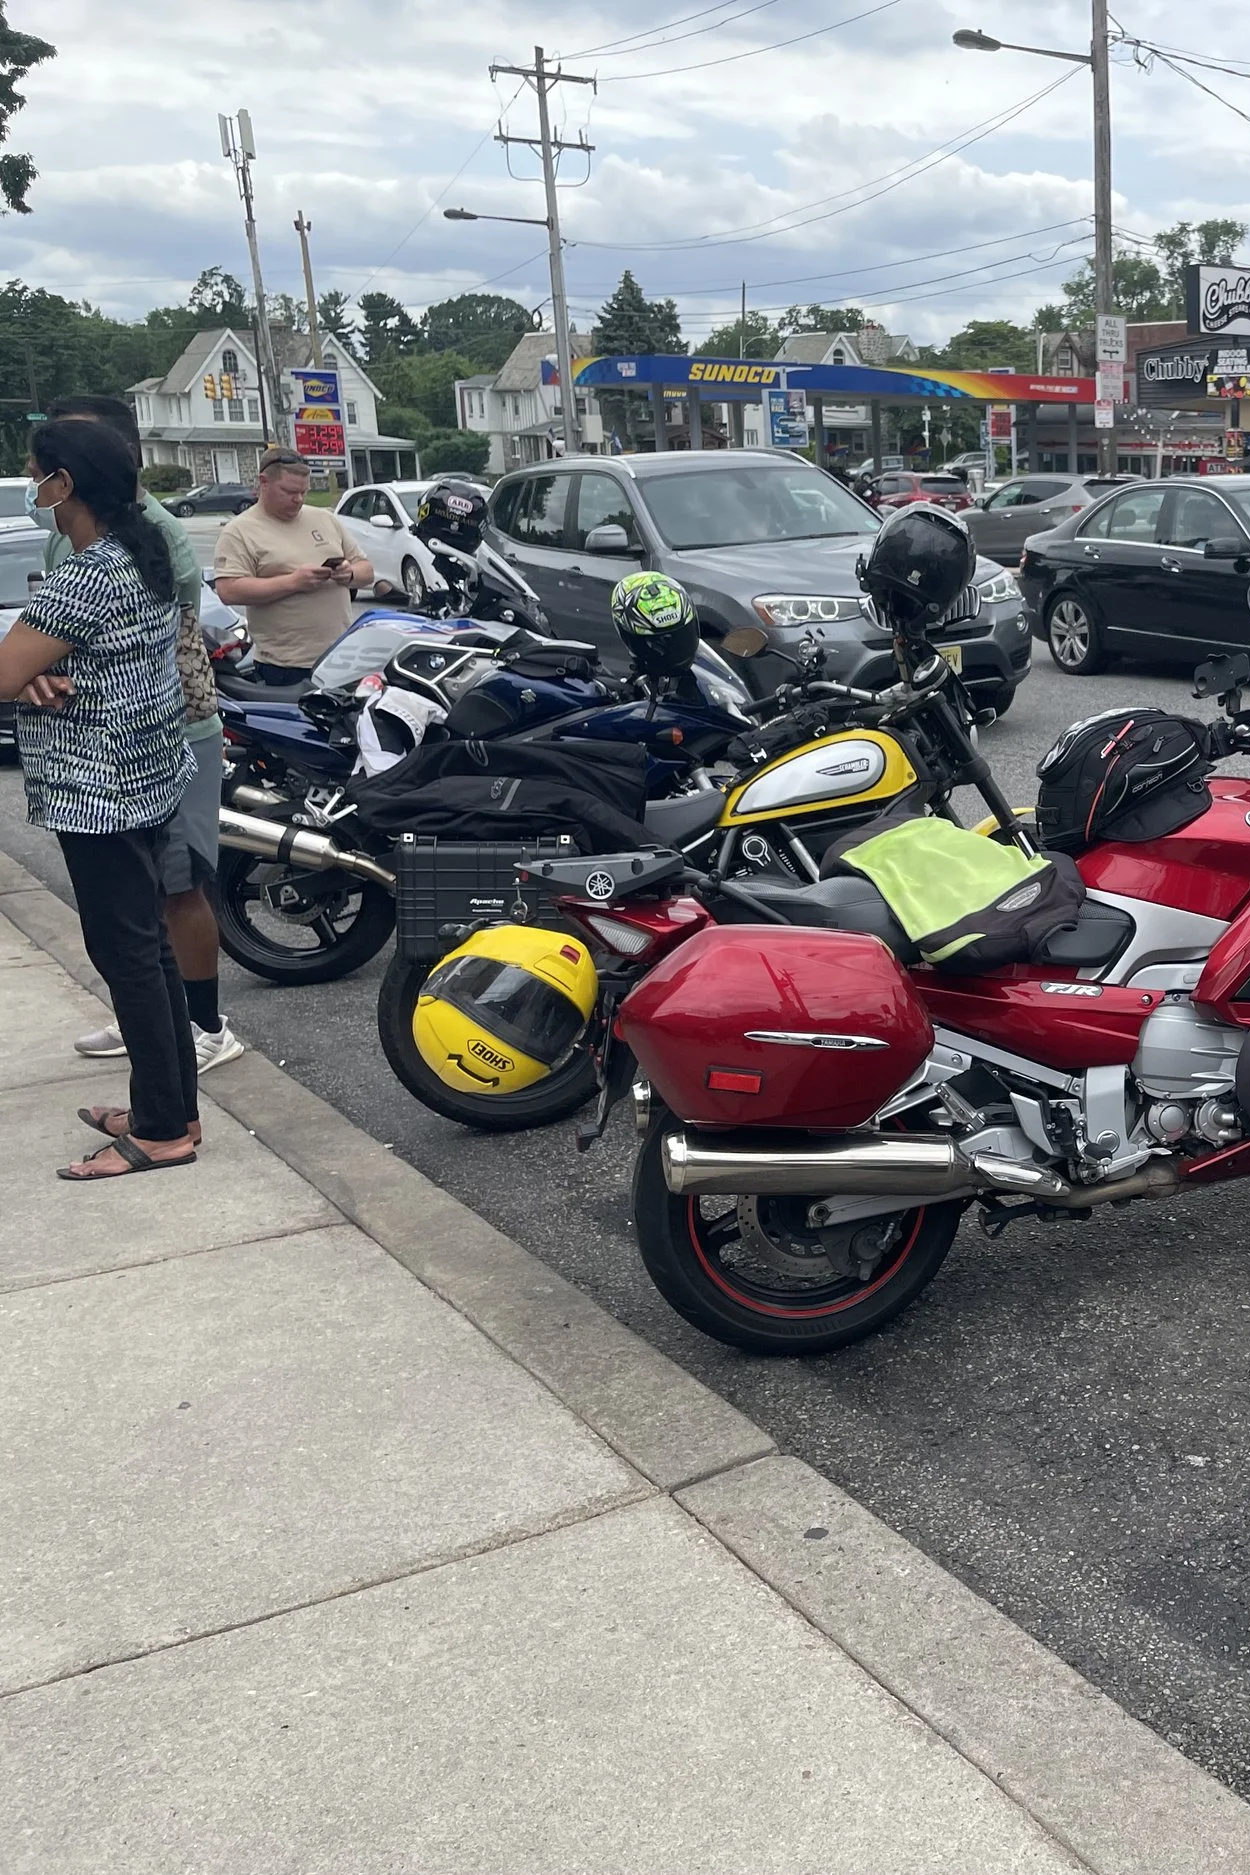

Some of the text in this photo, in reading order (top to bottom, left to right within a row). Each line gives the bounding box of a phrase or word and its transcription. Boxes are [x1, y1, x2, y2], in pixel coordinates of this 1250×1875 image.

[1104, 320, 1117, 328] ALL
[1102, 329, 1120, 338] THRU
[1099, 338, 1124, 348] TRUCKS
[1218, 349, 1247, 357] INDOOR
[1217, 357, 1248, 366] SEATING
[689, 363, 777, 384] SUNOCO
[1144, 355, 1210, 383] Chubby'
[304, 384, 335, 394] UNOCO
[656, 612, 678, 624] SHOEI
[839, 759, 869, 772] SCRAMBLER
[1044, 982, 1100, 996] FJR
[820, 1039, 846, 1047] YAMAHA
[471, 1042, 511, 1070] SHOEI
